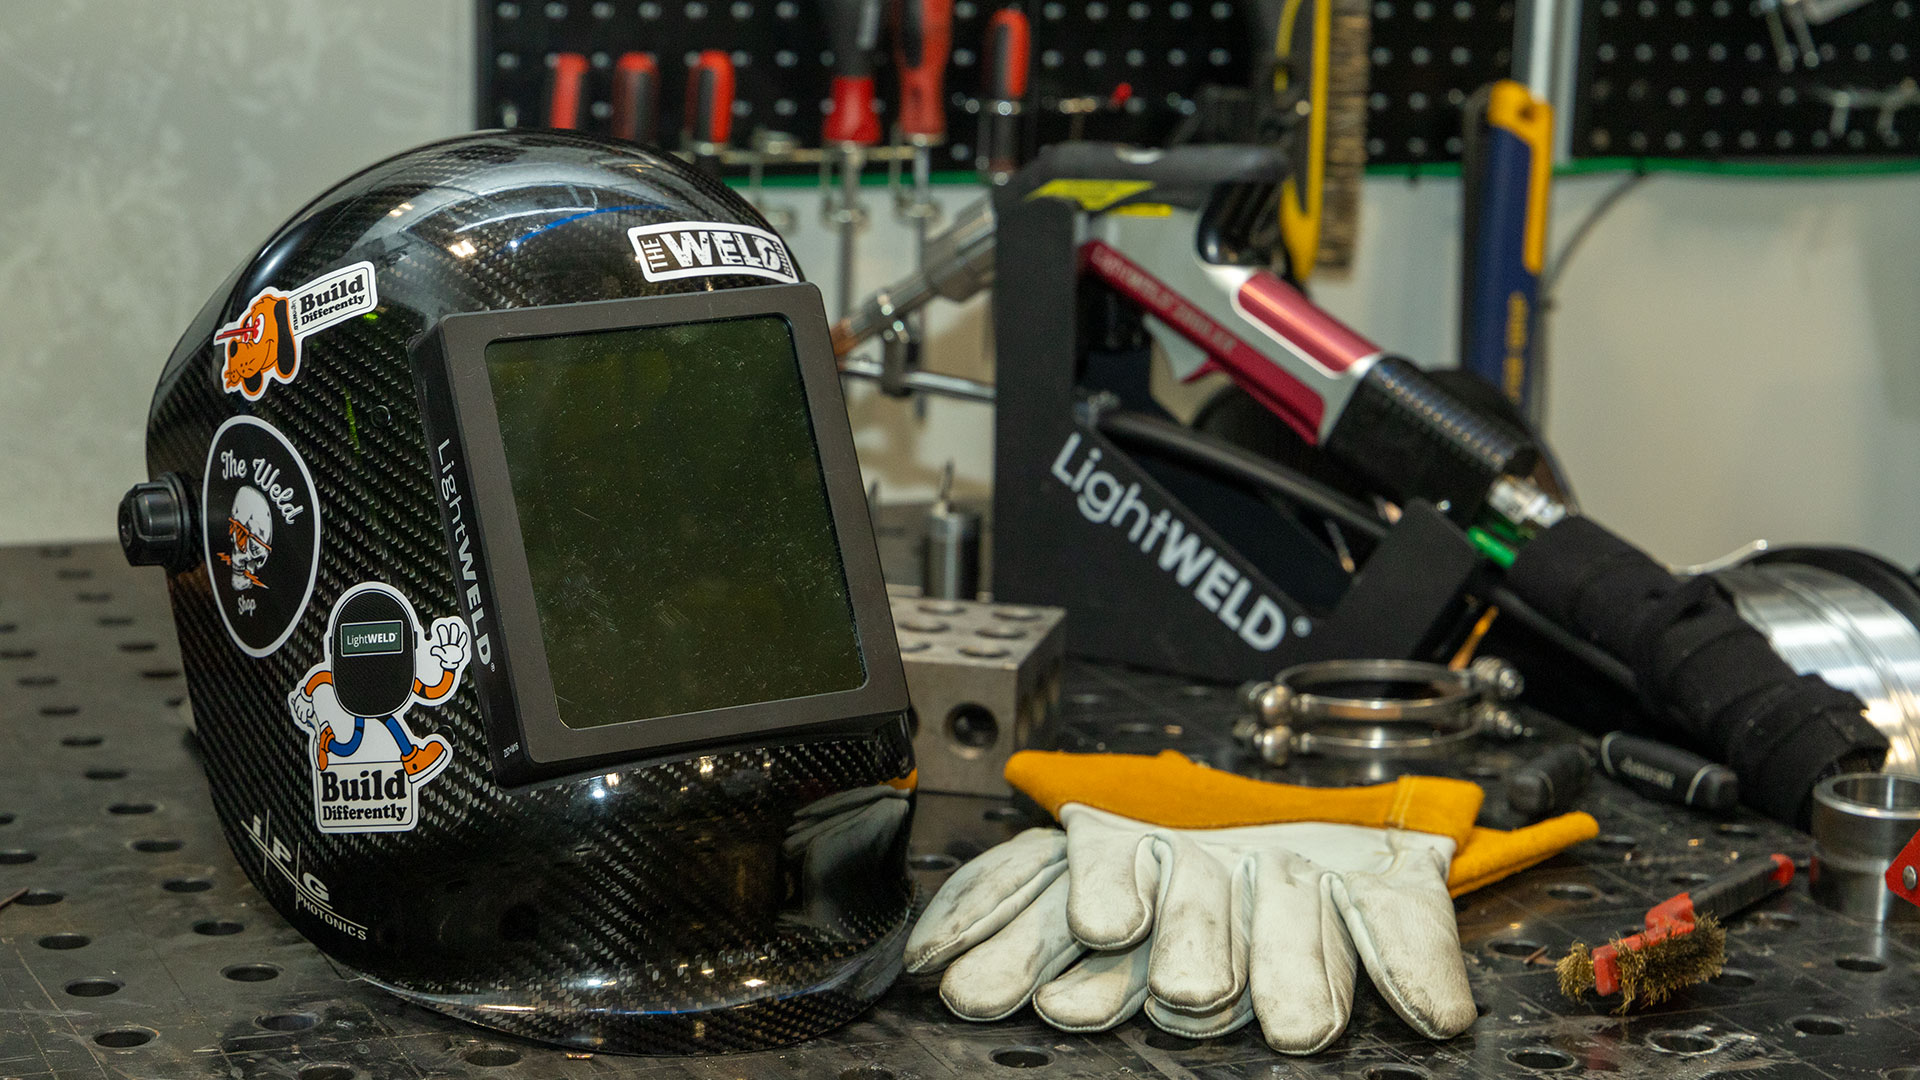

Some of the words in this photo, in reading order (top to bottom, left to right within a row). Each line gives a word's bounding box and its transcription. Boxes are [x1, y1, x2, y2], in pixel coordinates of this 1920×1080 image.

[641, 238, 669, 271] THE
[659, 231, 782, 271] WELD
[300, 274, 365, 315] Build
[301, 294, 366, 326] Differently
[220, 449, 248, 480] The
[252, 458, 304, 525] Weld
[237, 594, 257, 616] Shop
[320, 769, 407, 802] Build
[322, 803, 407, 822] Differently
[297, 895, 367, 941] PHOTONICS
